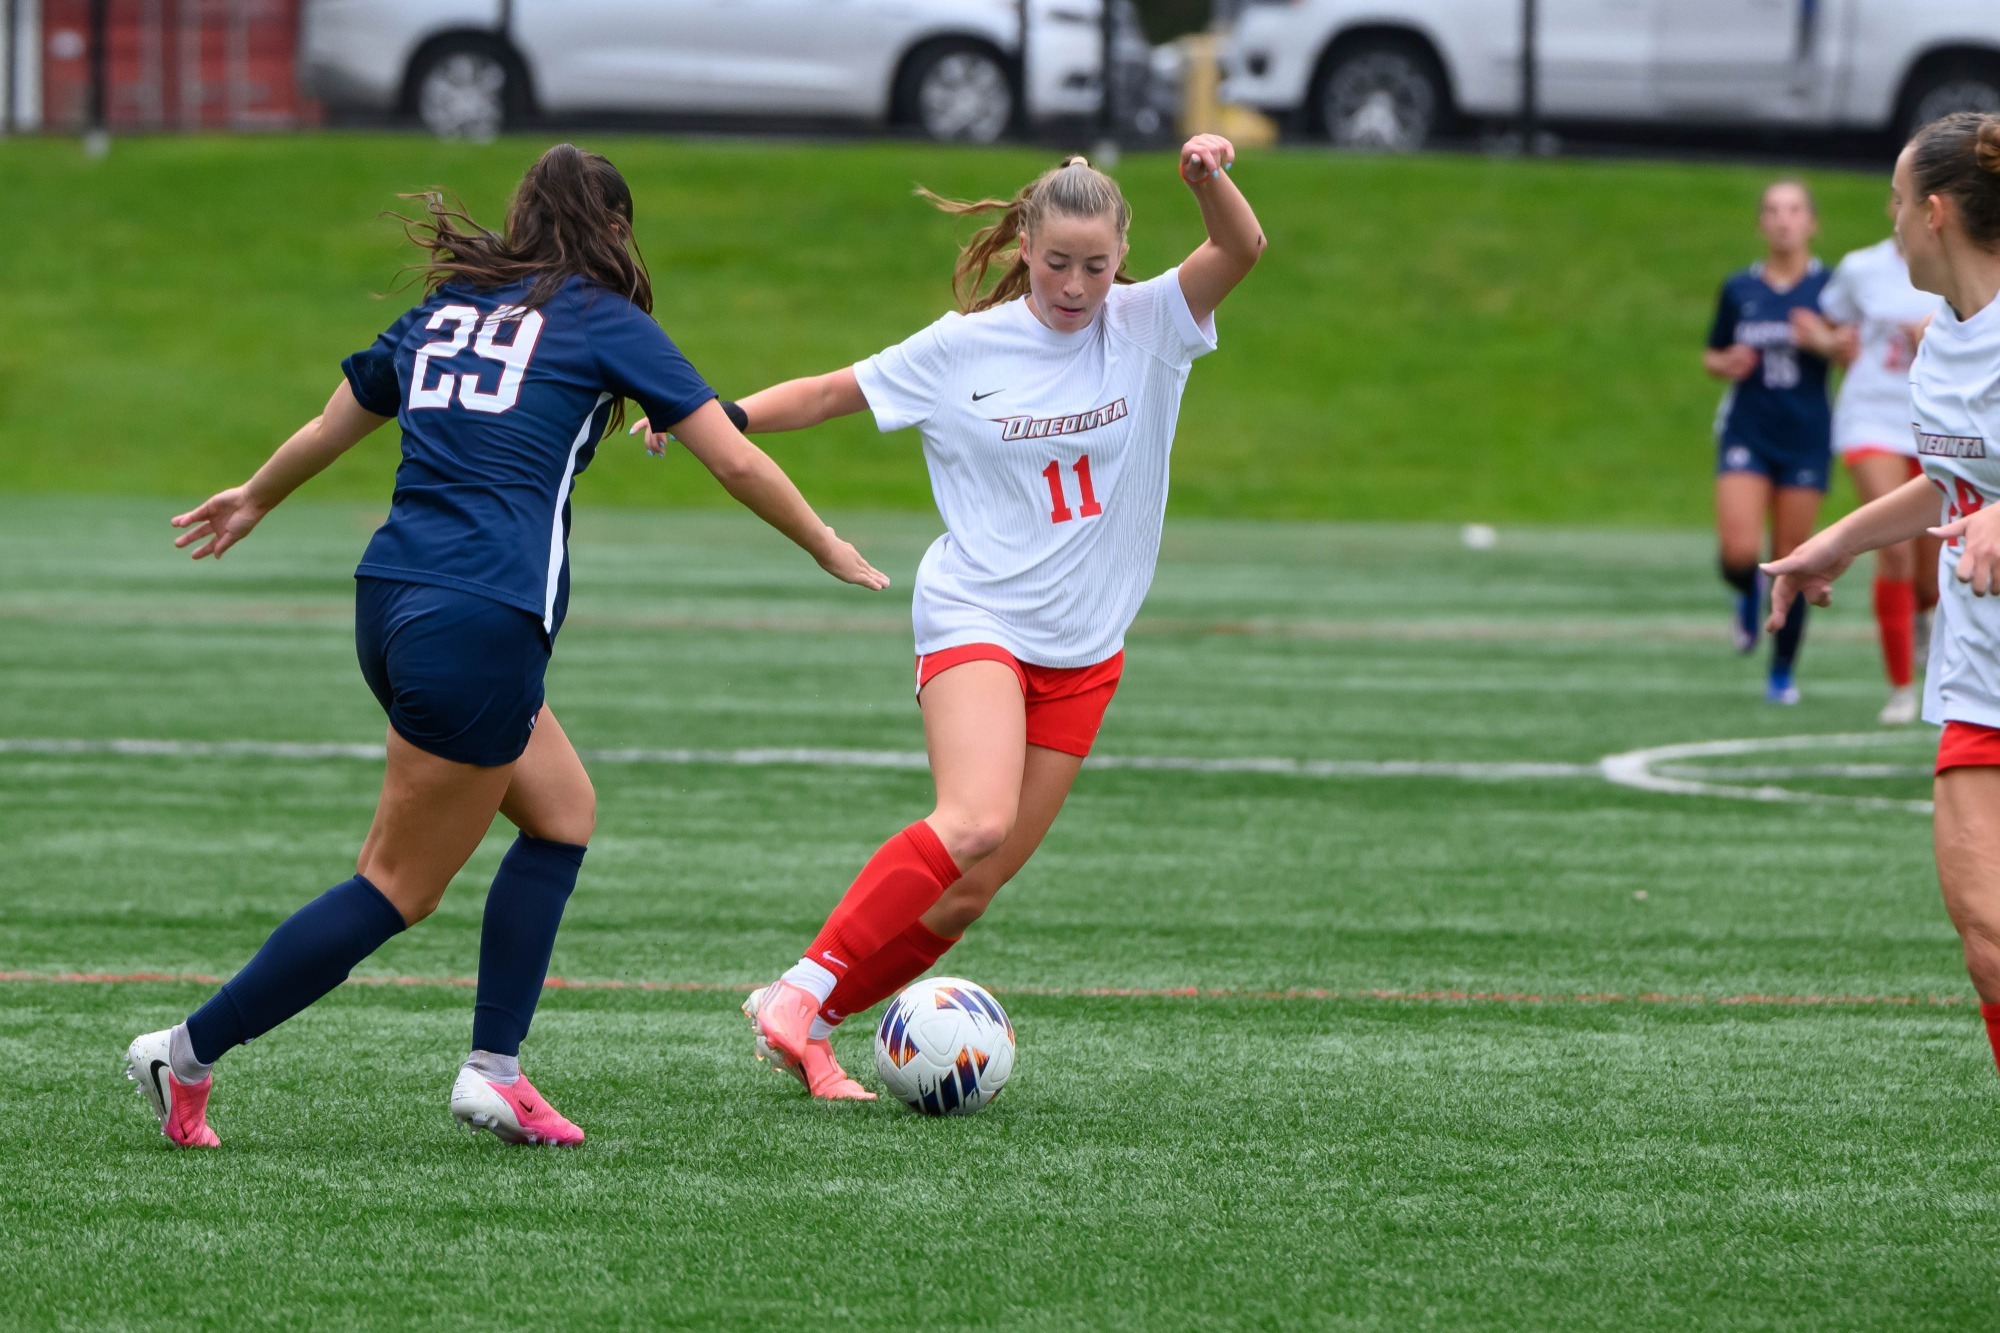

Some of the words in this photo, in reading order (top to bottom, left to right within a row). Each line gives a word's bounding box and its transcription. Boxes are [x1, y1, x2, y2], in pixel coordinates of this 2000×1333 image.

[408, 304, 546, 414] 29
[988, 397, 1128, 441] ONEONTA
[1042, 454, 1102, 524] 11
